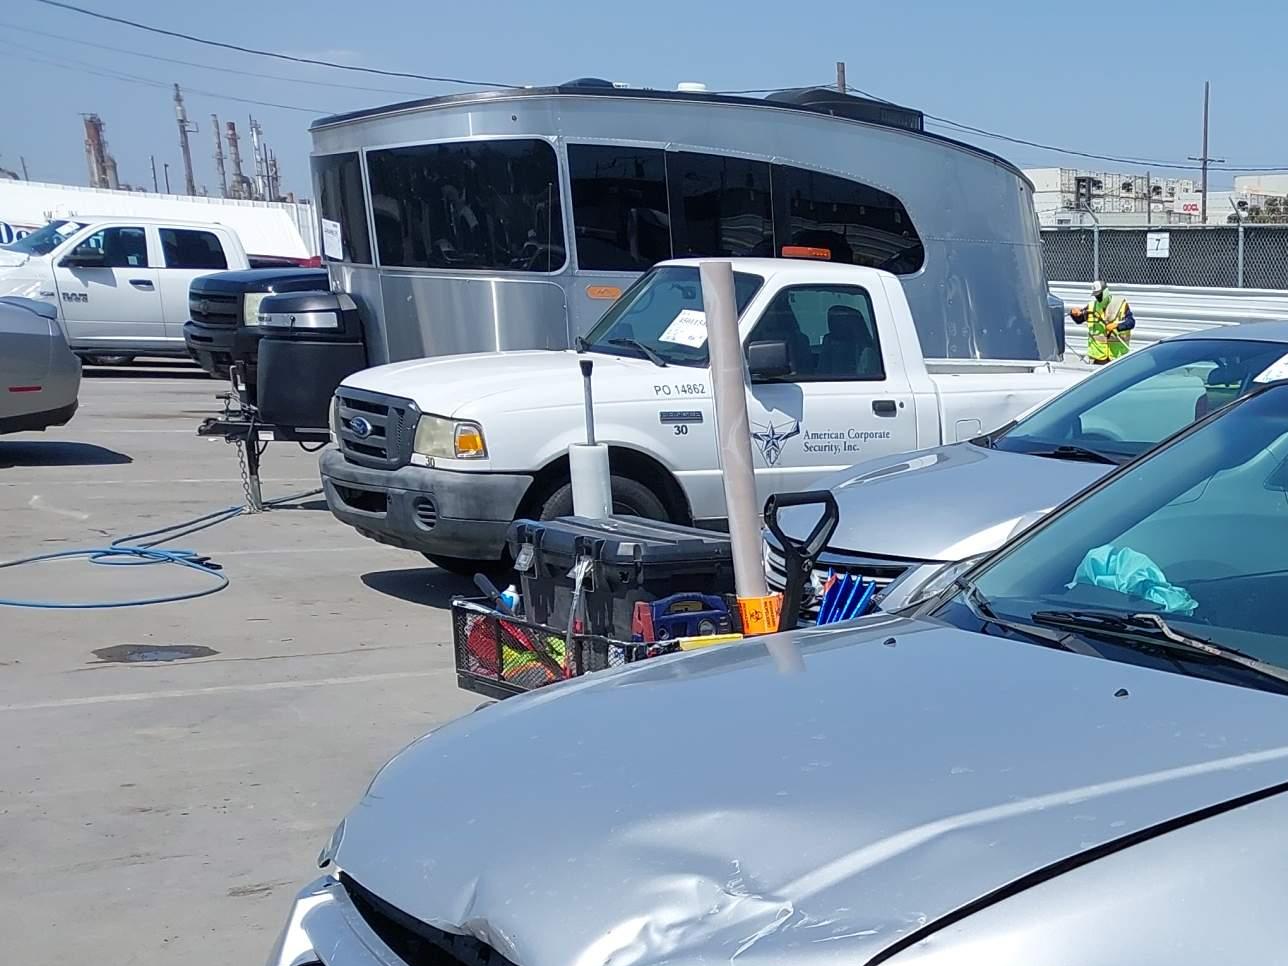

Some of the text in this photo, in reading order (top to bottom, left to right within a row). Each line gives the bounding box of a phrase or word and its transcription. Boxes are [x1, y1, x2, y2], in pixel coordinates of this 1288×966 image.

[1155, 238, 1161, 251] 7
[654, 383, 705, 395] PO 14862
[674, 424, 688, 435] 30
[803, 428, 891, 443] American Corporate
[803, 441, 860, 454] Security, Inc.
[425, 456, 435, 468] 30
